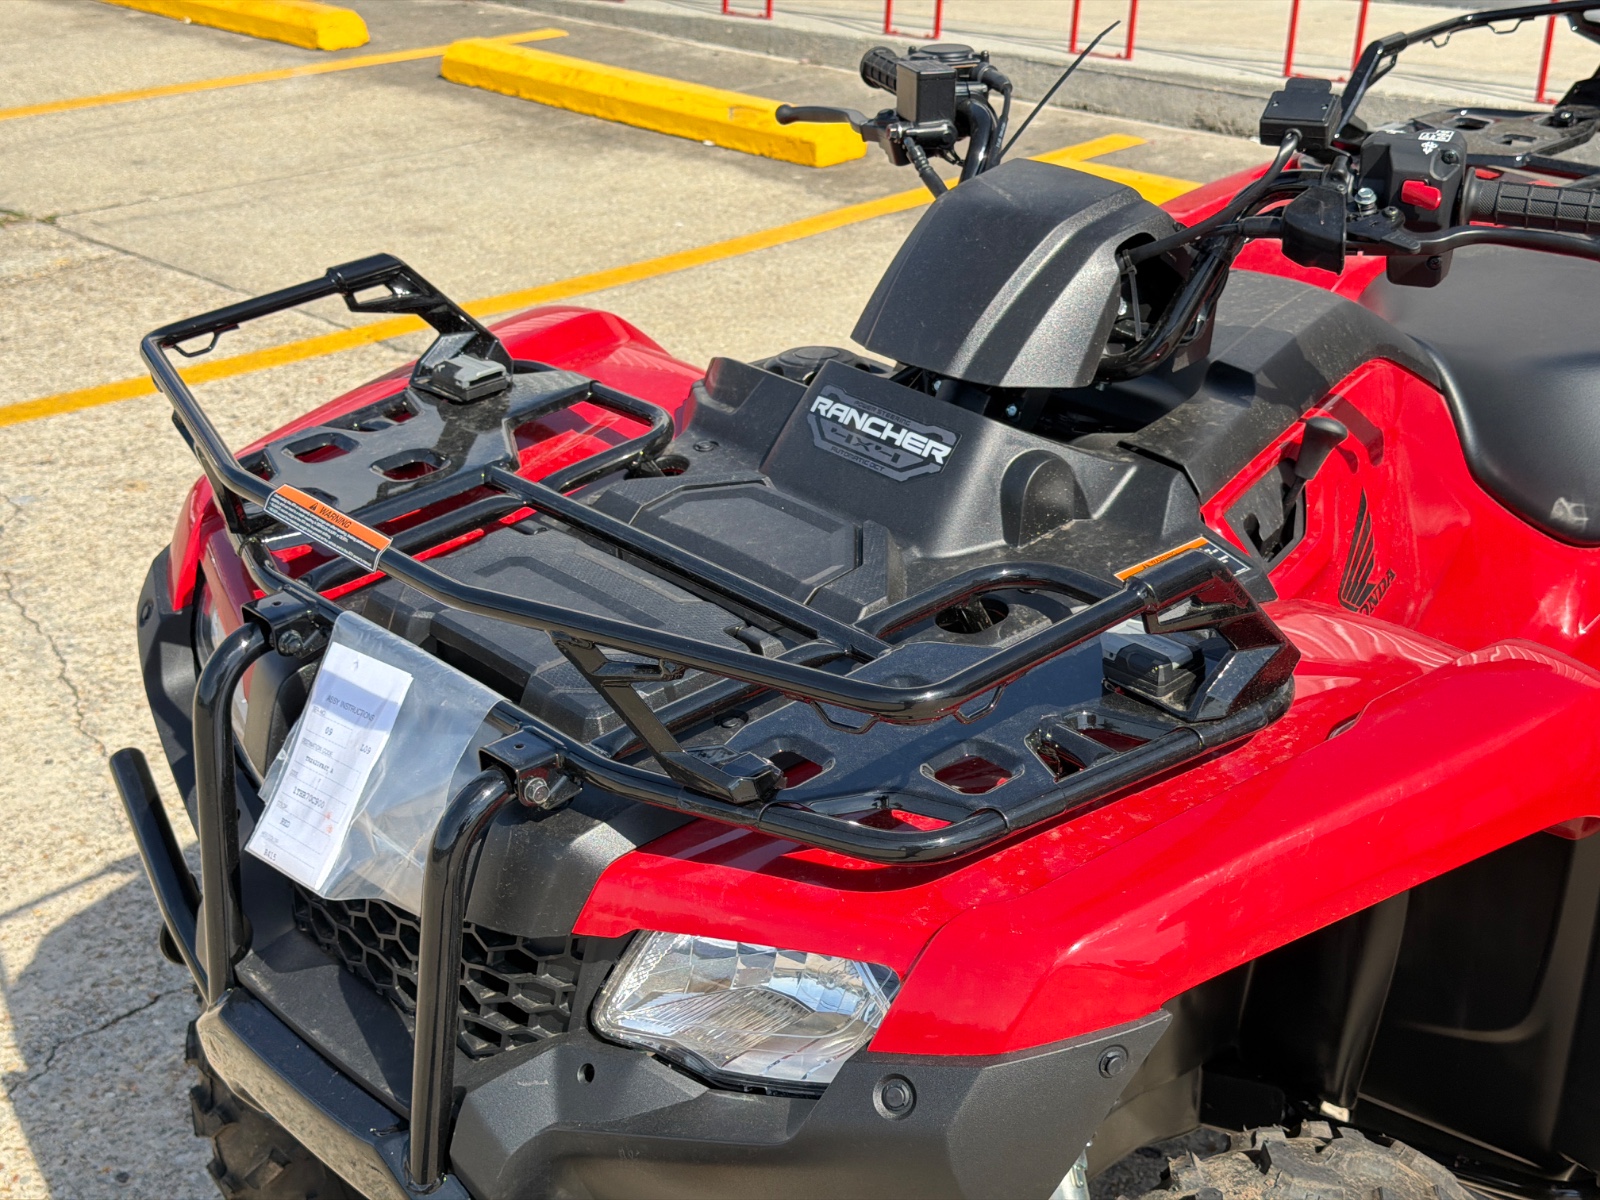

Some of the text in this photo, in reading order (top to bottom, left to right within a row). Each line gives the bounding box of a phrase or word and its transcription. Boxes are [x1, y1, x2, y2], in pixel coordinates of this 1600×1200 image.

[854, 400, 912, 426] POWER STEERING
[810, 395, 952, 464] RANCHER
[830, 446, 869, 465] AUTOMATIC
[319, 506, 352, 529] WARNING
[1359, 568, 1397, 616] ONDA
[326, 694, 376, 722] ASSY INSTRUCTIONS
